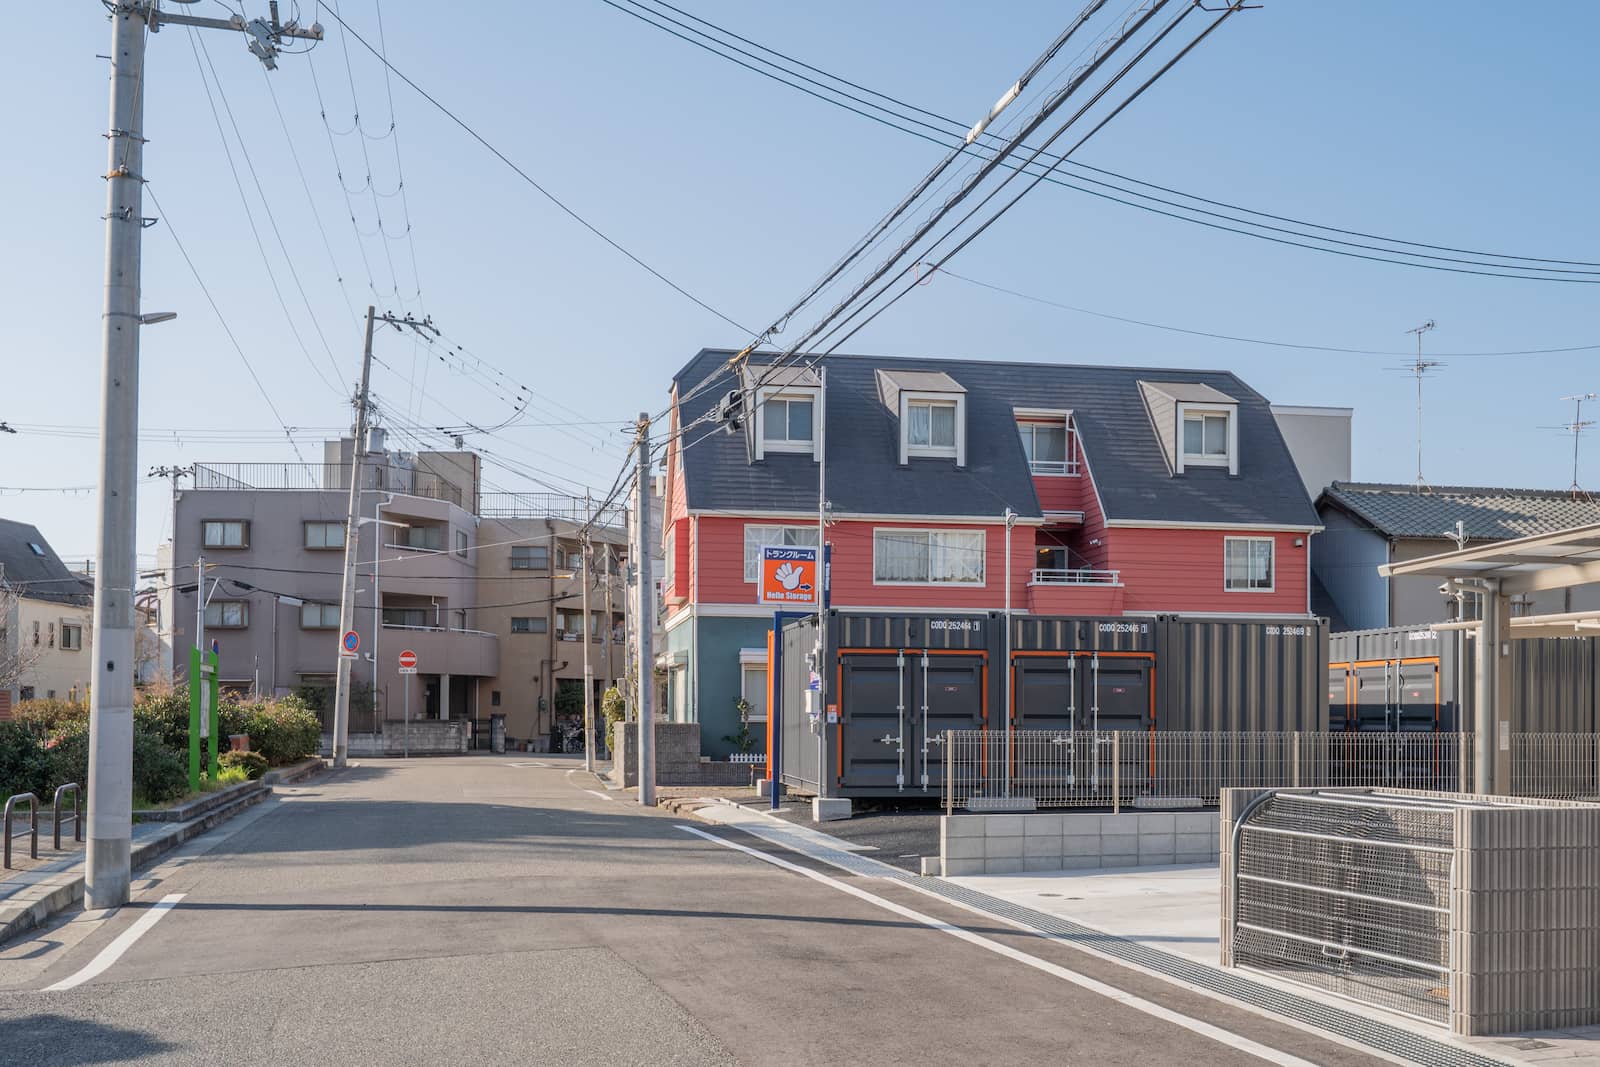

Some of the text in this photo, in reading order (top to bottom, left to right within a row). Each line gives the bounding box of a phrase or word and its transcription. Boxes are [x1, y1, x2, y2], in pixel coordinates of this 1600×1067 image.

[766, 550, 814, 559] トランクルーム
[786, 592, 812, 600] Storage
